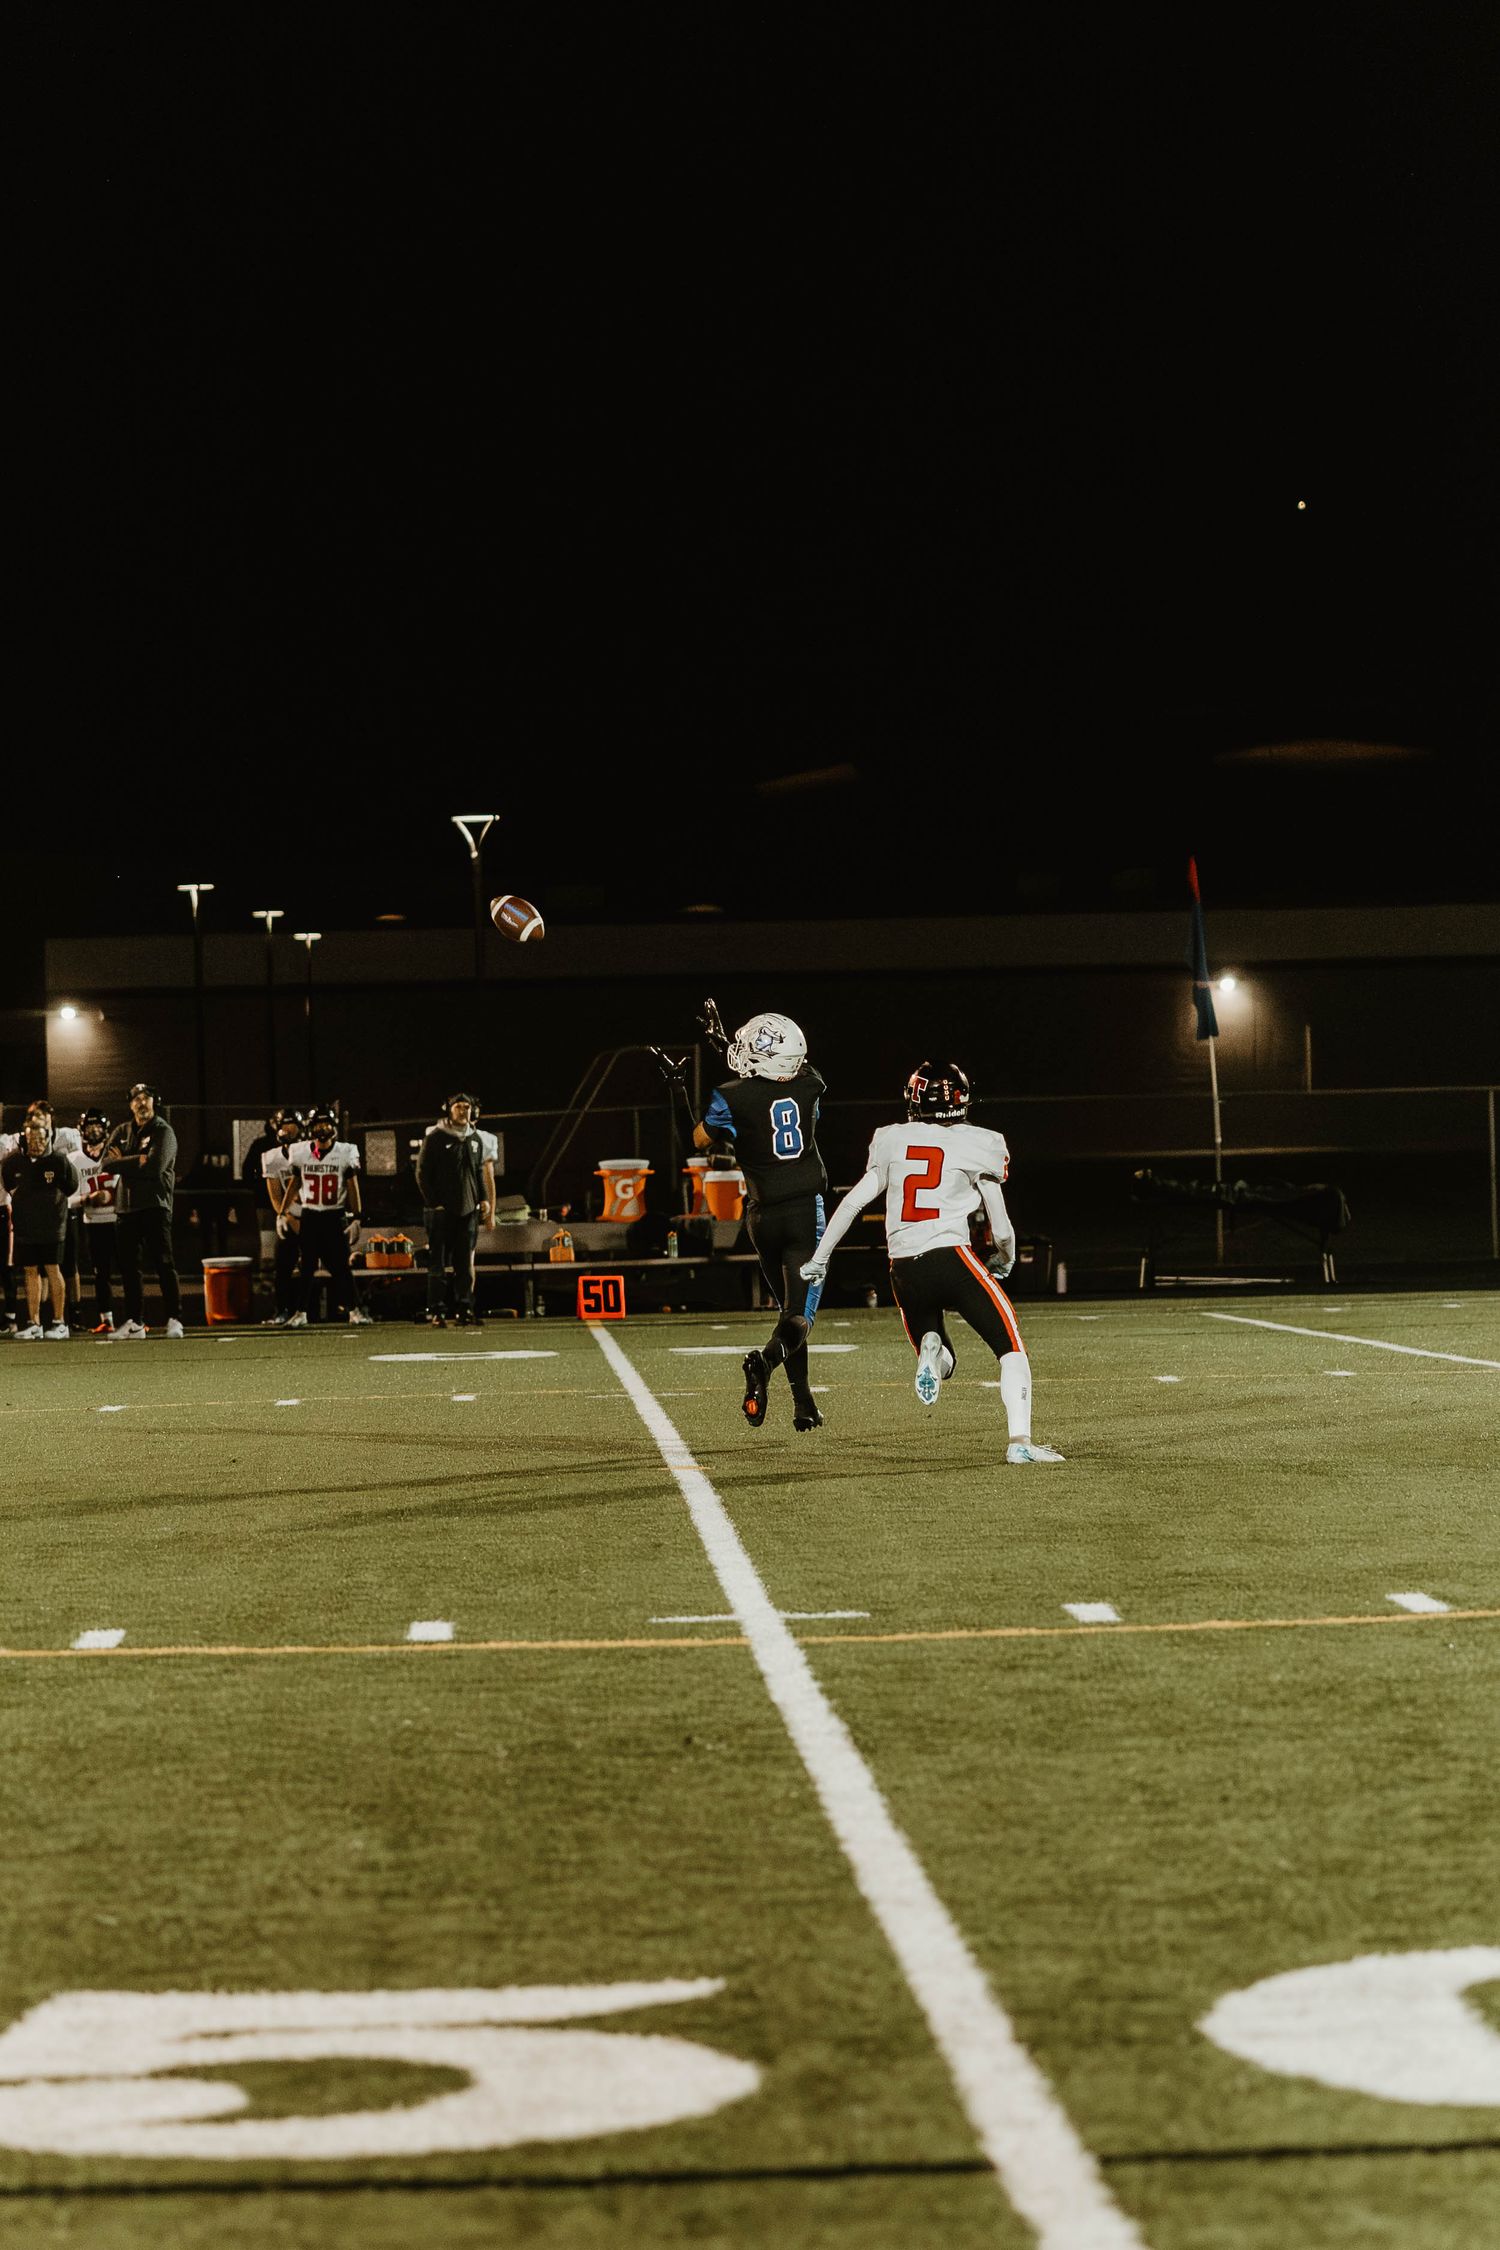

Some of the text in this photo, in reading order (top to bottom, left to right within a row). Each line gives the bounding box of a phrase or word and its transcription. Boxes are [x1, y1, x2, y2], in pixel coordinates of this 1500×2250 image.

[909, 1075, 929, 1104] T
[770, 1097, 804, 1160] 8
[935, 1108, 967, 1119] Riddell
[303, 1163, 340, 1173] THURSTON
[304, 1174, 339, 1206] 38
[615, 1178, 634, 1200] G
[900, 1145, 945, 1223] 2
[583, 1279, 622, 1313] 50
